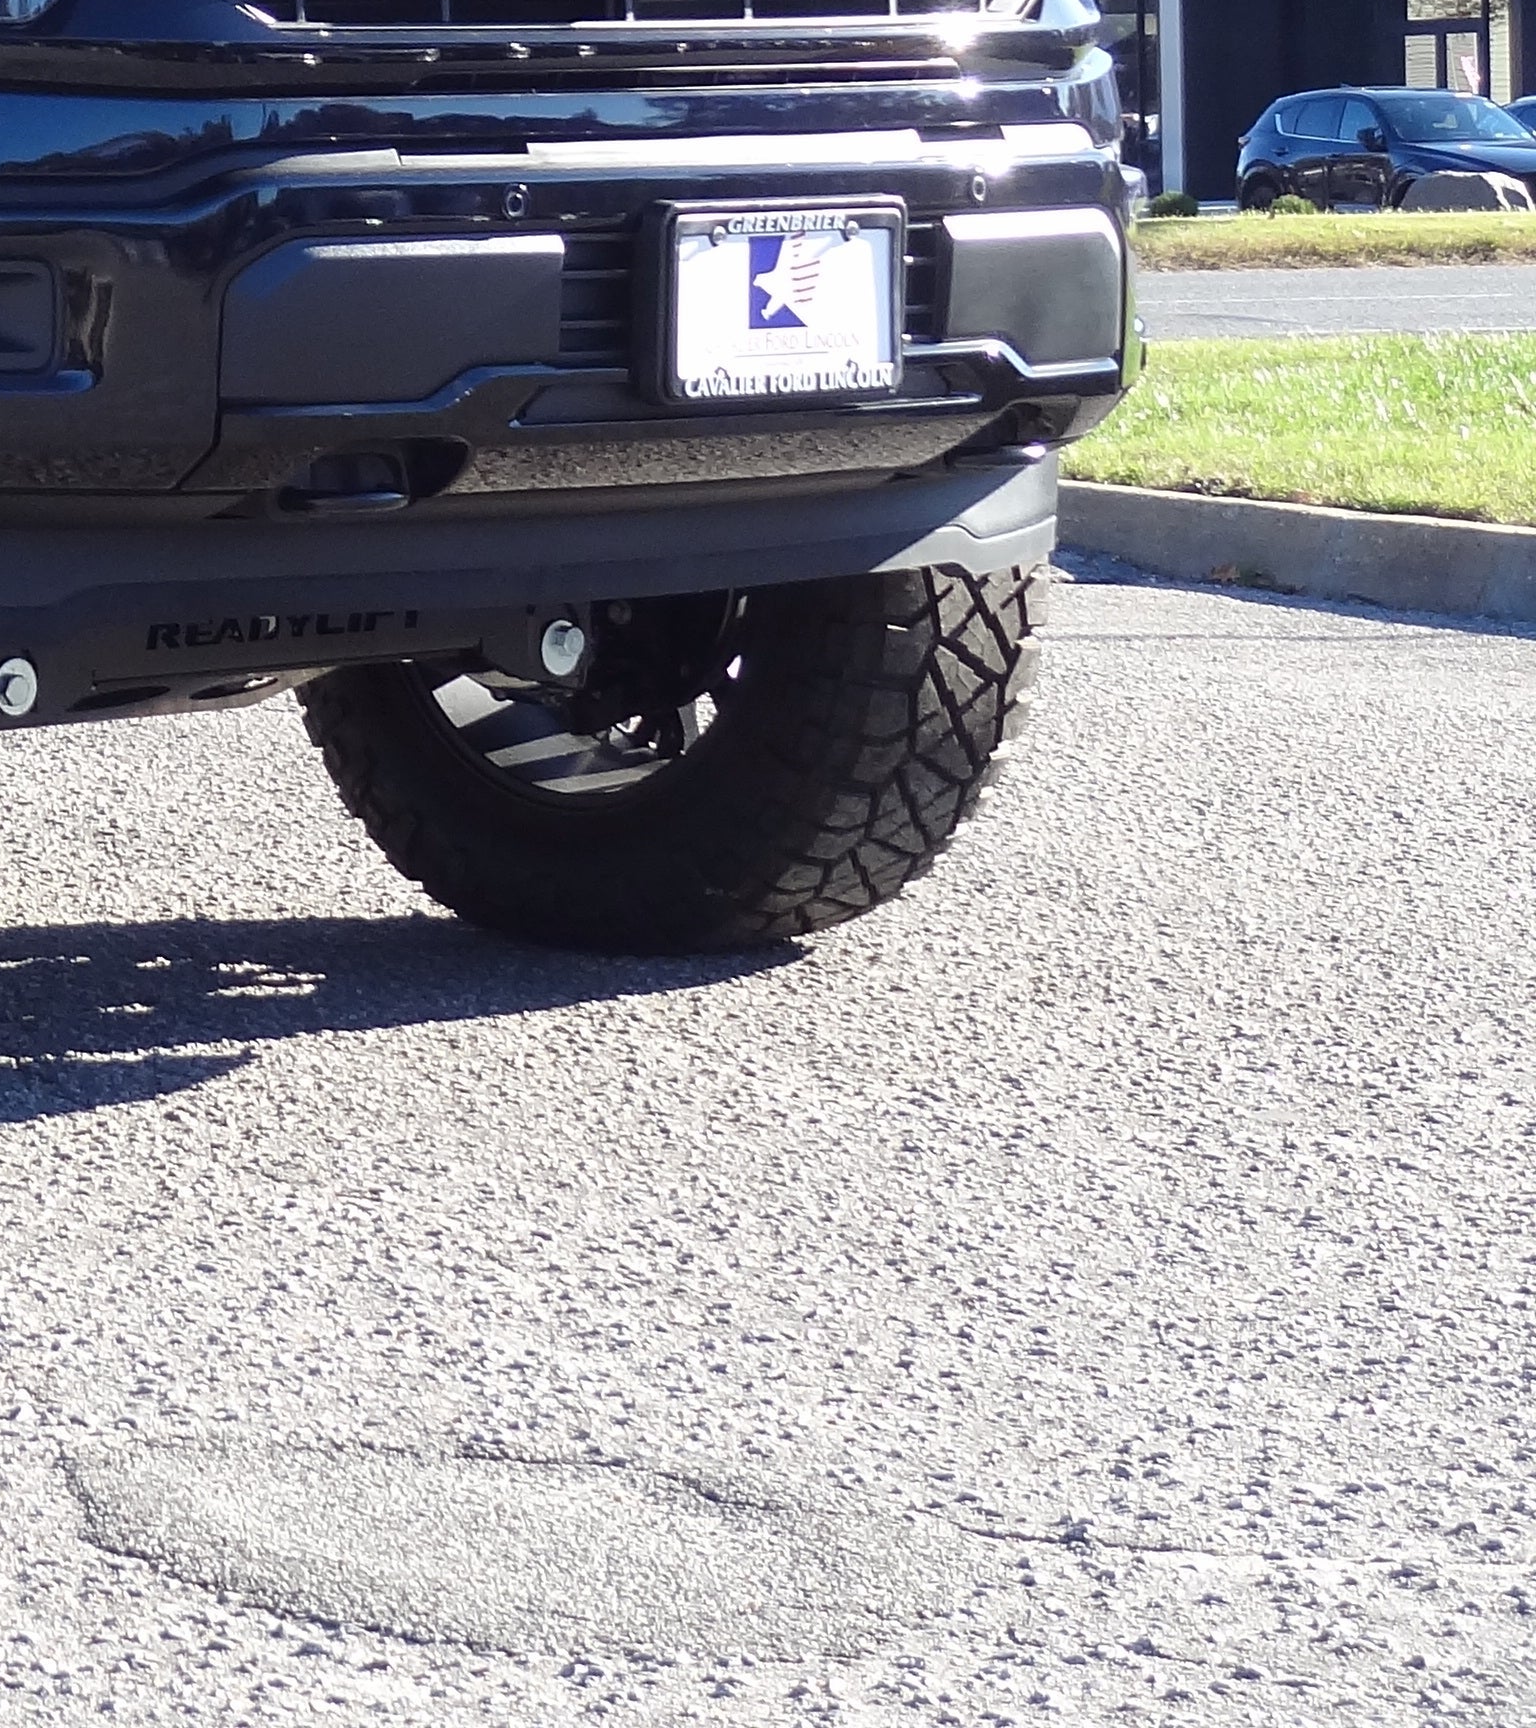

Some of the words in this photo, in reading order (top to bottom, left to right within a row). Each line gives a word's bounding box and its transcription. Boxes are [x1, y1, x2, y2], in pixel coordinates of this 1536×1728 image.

[728, 214, 846, 234] GREENBRIER
[684, 375, 767, 398] CAVALIER
[770, 373, 818, 393] FORD
[820, 367, 893, 390] LINCOLN
